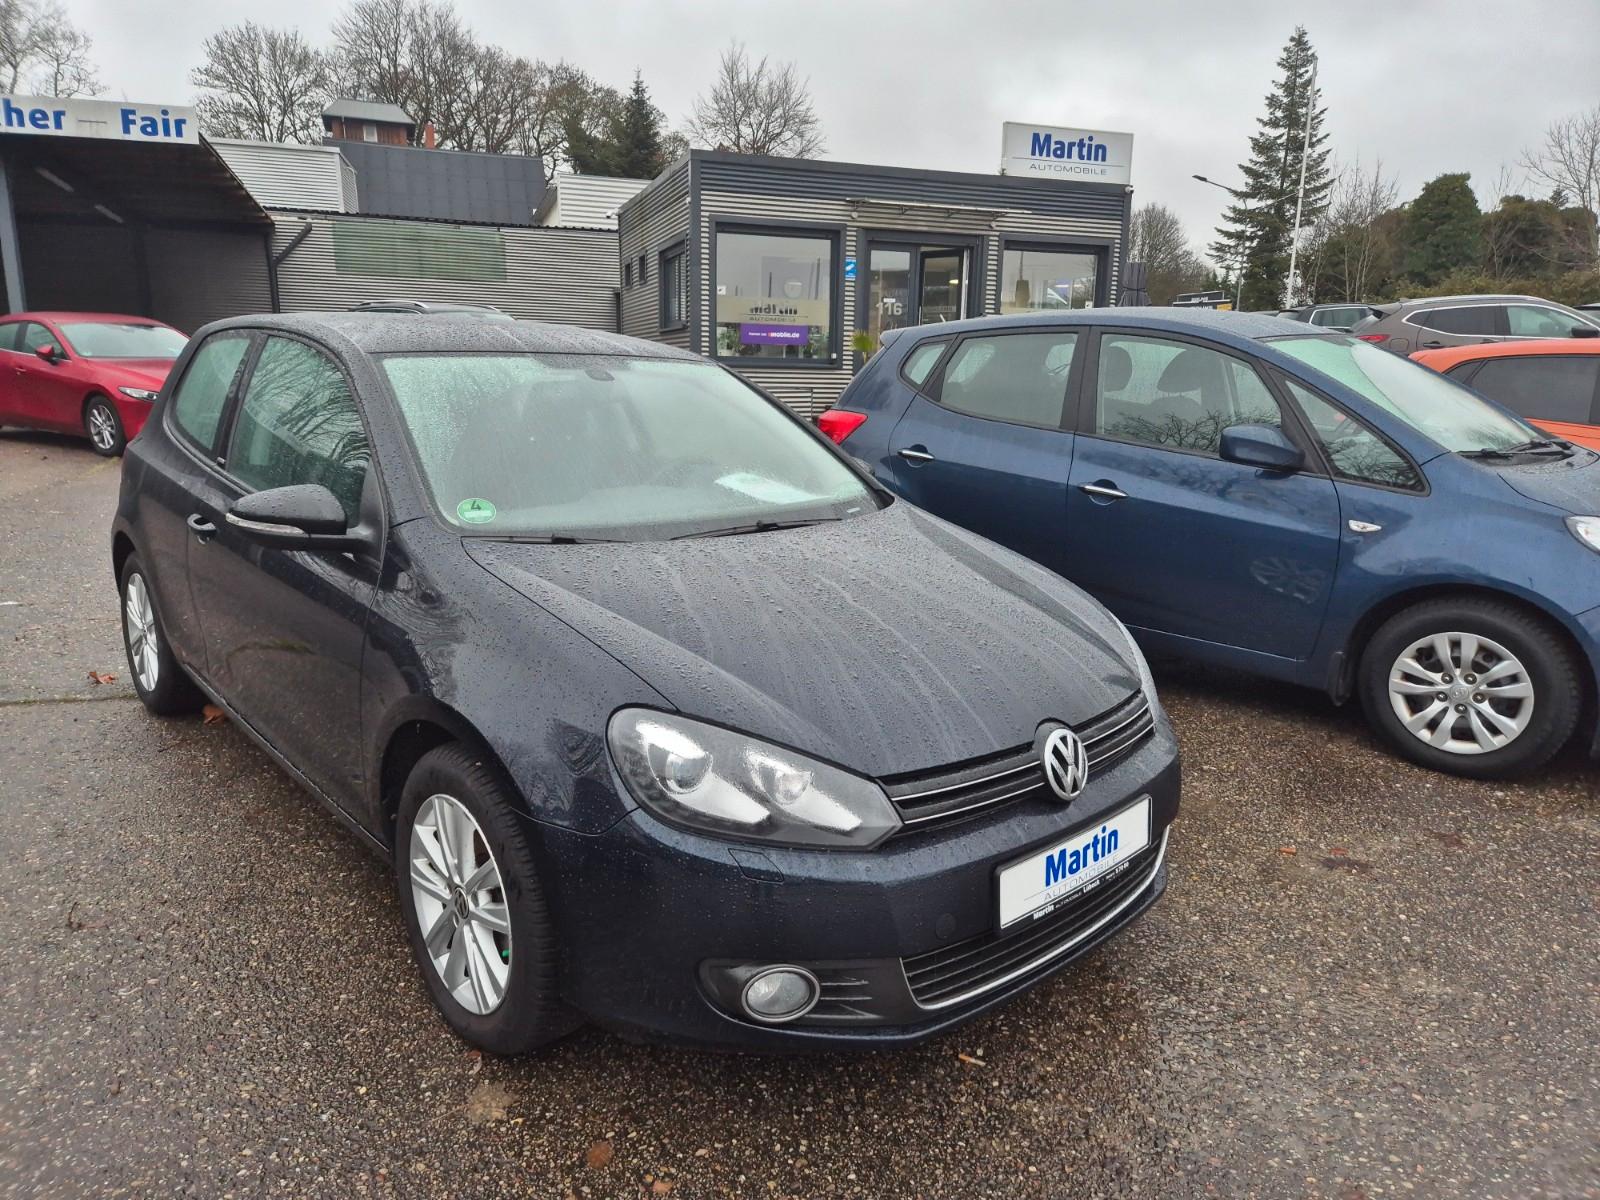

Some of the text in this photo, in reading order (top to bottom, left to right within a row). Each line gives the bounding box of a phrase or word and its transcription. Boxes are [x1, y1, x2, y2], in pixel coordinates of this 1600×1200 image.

[0, 97, 186, 138] her Fair
[1031, 132, 1107, 162] Martin
[1029, 163, 1107, 175] AUTOMOBILE
[876, 302, 903, 316] 116
[1046, 826, 1118, 888] Martin
[1044, 855, 1119, 903] AUTOMOBILE
